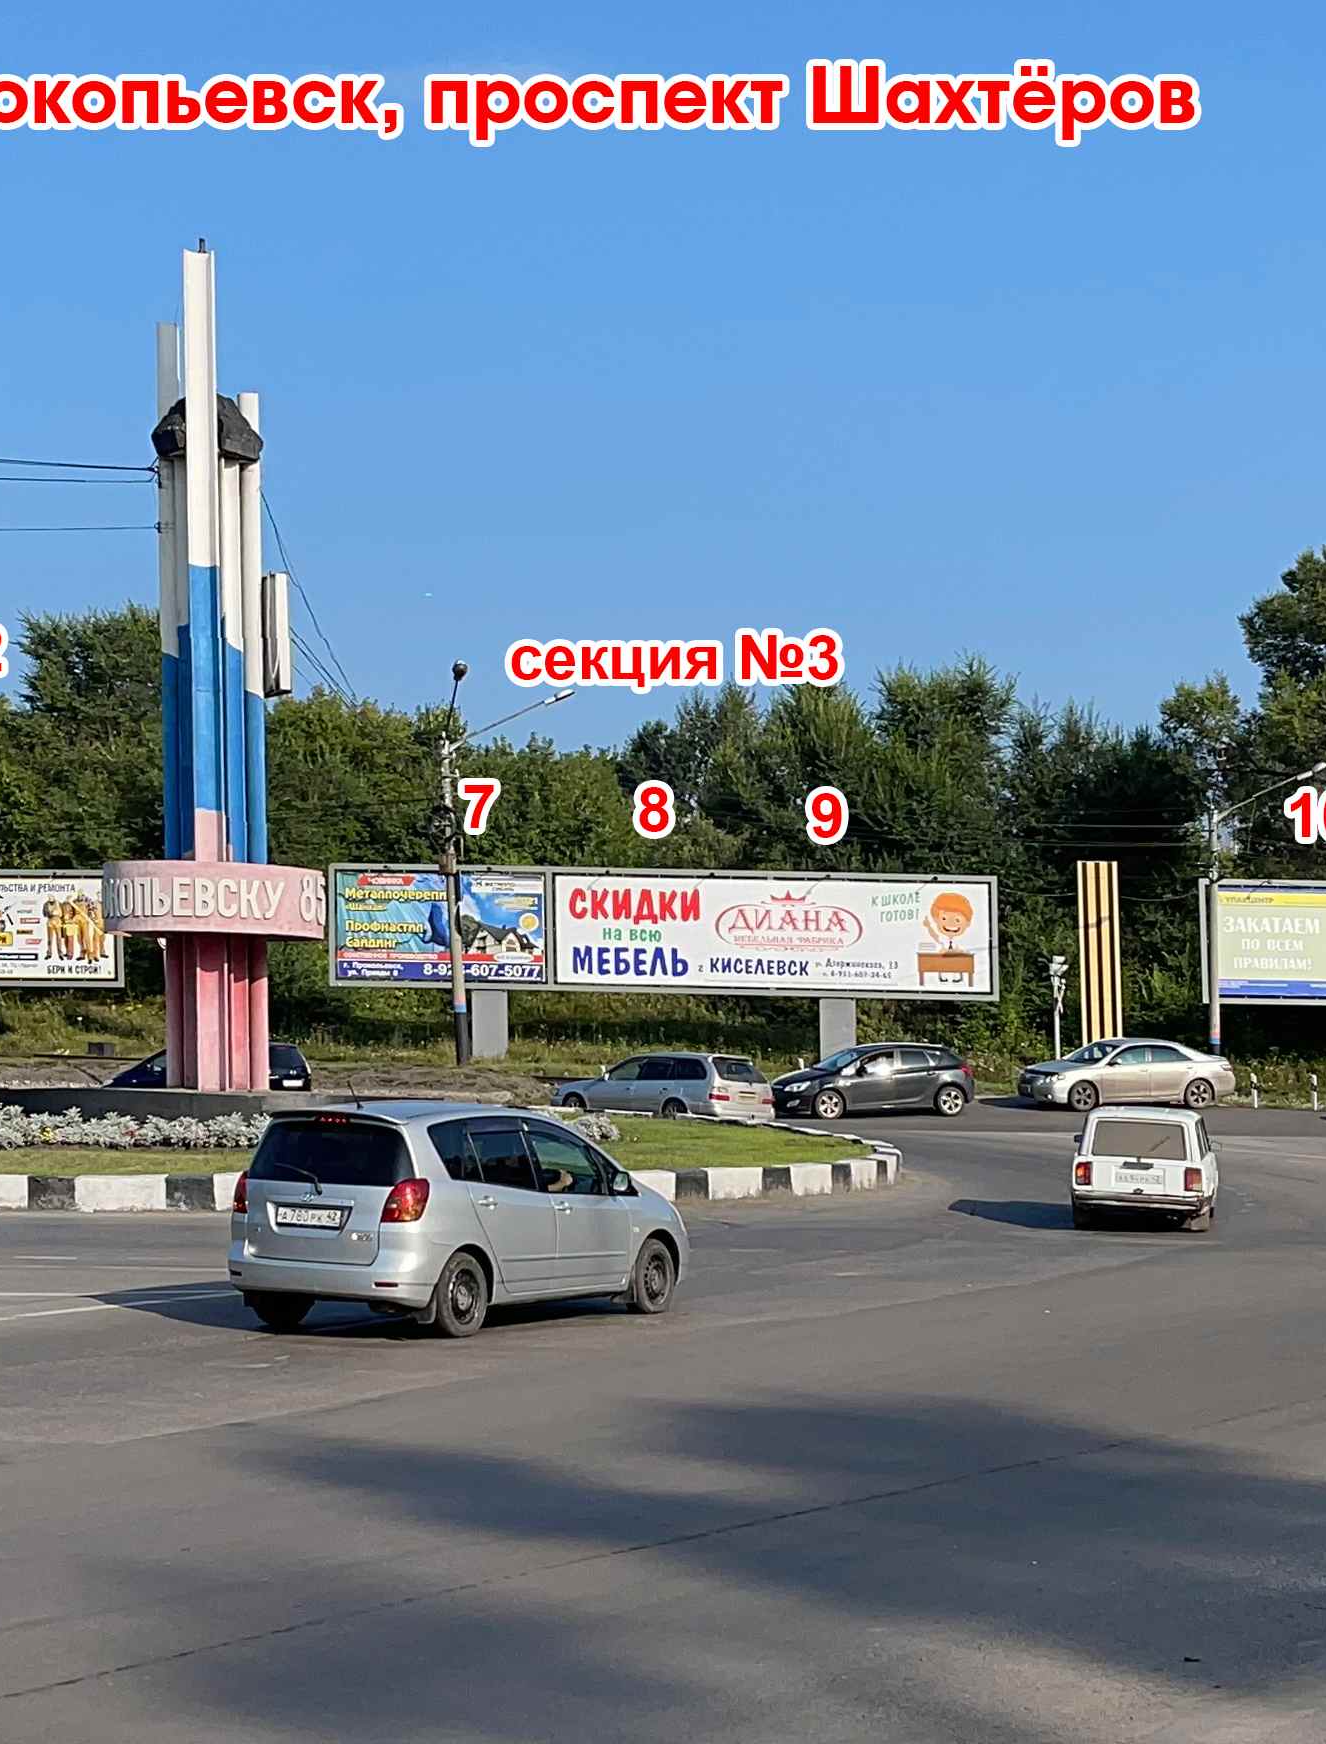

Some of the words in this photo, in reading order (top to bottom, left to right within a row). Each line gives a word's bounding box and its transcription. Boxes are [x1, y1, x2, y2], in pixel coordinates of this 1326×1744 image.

[38, 883, 76, 894] РЕМОНТА
[568, 887, 700, 925] СКИДКИ
[871, 894, 880, 906] К
[881, 891, 921, 907] ШКОЛЕ
[728, 908, 850, 934] ДИАНА
[880, 908, 920, 923] ГОТОВ!
[1223, 916, 1321, 935] ЗАКАТАЕМ
[602, 927, 622, 941] на
[629, 927, 662, 942] всю
[796, 936, 844, 945] ФАБРИКА
[345, 936, 397, 950] Сайдинг
[1241, 938, 1260, 951] ПО
[1267, 939, 1304, 951] ВСЕМ
[572, 945, 689, 977] МЕБЕЛЬ
[709, 956, 810, 977] КИСЕЛЕВСК
[1233, 956, 1313, 972] ПРАВИЛАМ!
[47, 964, 65, 975] БЕРИ
